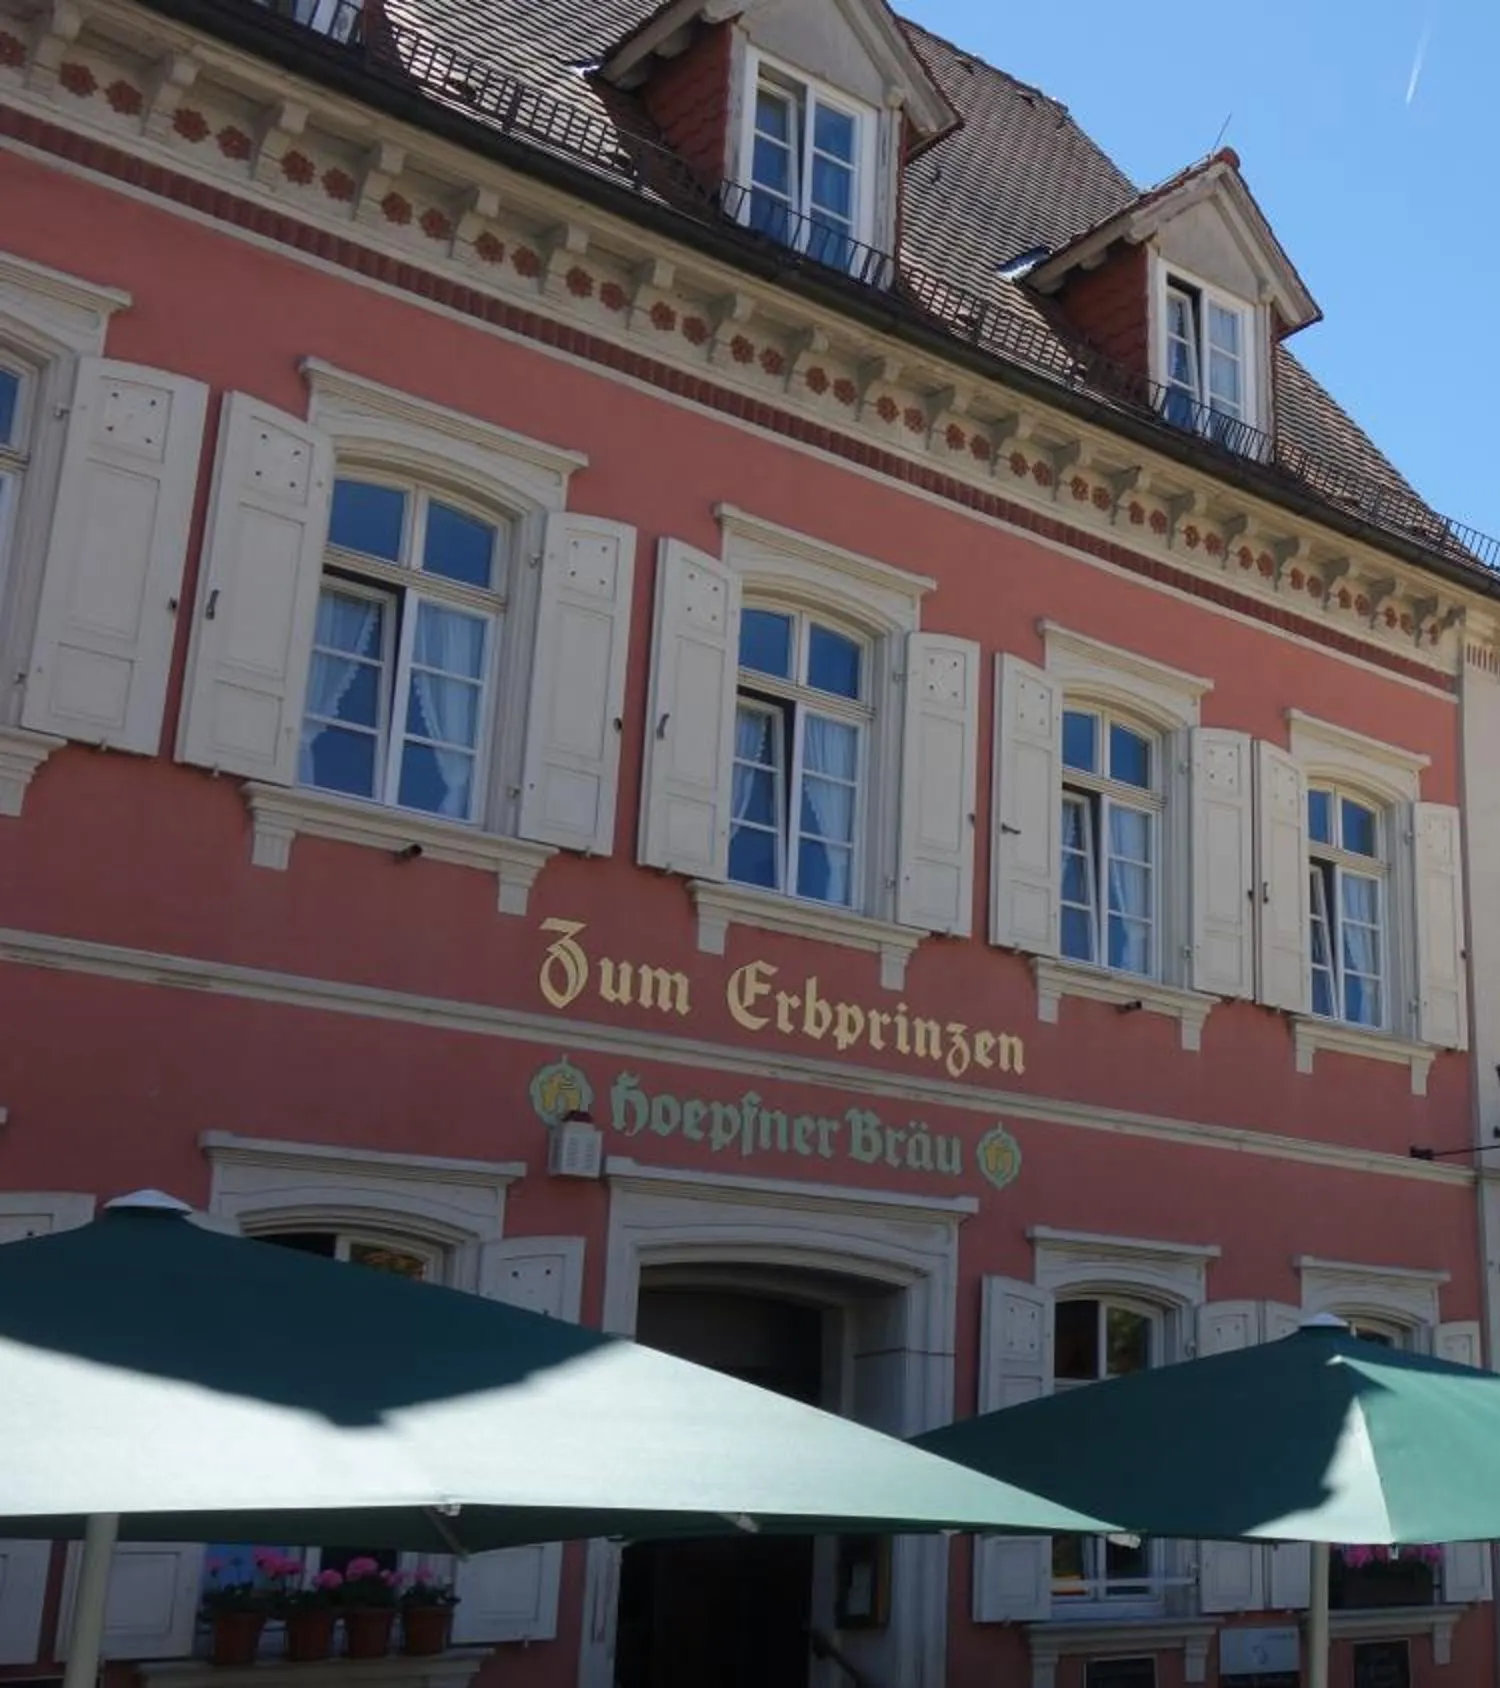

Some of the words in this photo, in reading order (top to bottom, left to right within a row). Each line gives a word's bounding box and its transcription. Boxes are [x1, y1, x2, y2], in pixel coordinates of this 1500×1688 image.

[538, 917, 692, 1016] Zum
[726, 959, 1027, 1077] Erbprinzen
[609, 1070, 841, 1158] Hoepfner
[844, 1106, 964, 1176] Bräu
